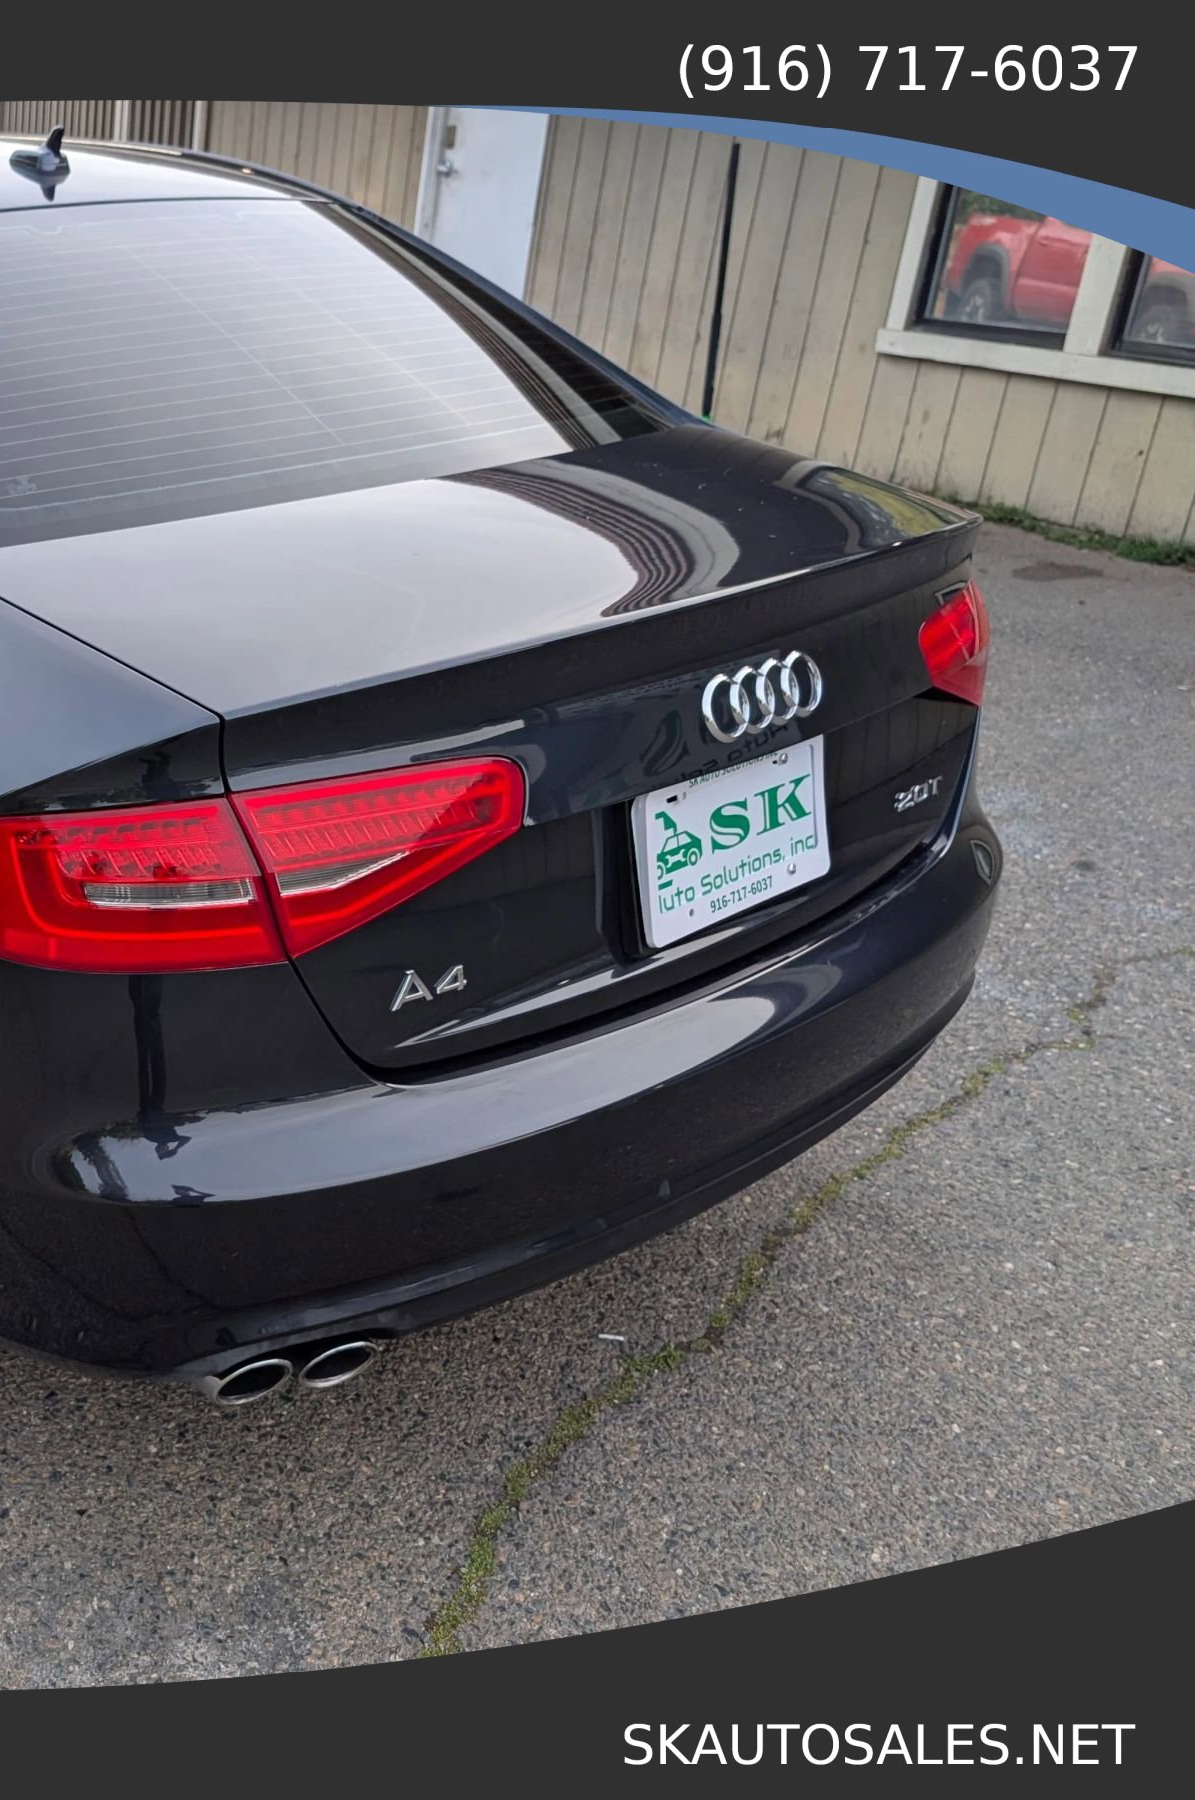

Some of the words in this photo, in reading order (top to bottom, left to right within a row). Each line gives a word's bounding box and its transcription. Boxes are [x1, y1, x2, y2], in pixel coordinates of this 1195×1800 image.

[709, 774, 812, 854] SK
[659, 886, 696, 914] uto
[700, 848, 786, 896] Solutions,
[790, 834, 815, 857] inc
[709, 875, 773, 914] 916-717-6037
[389, 964, 468, 1012] A4
